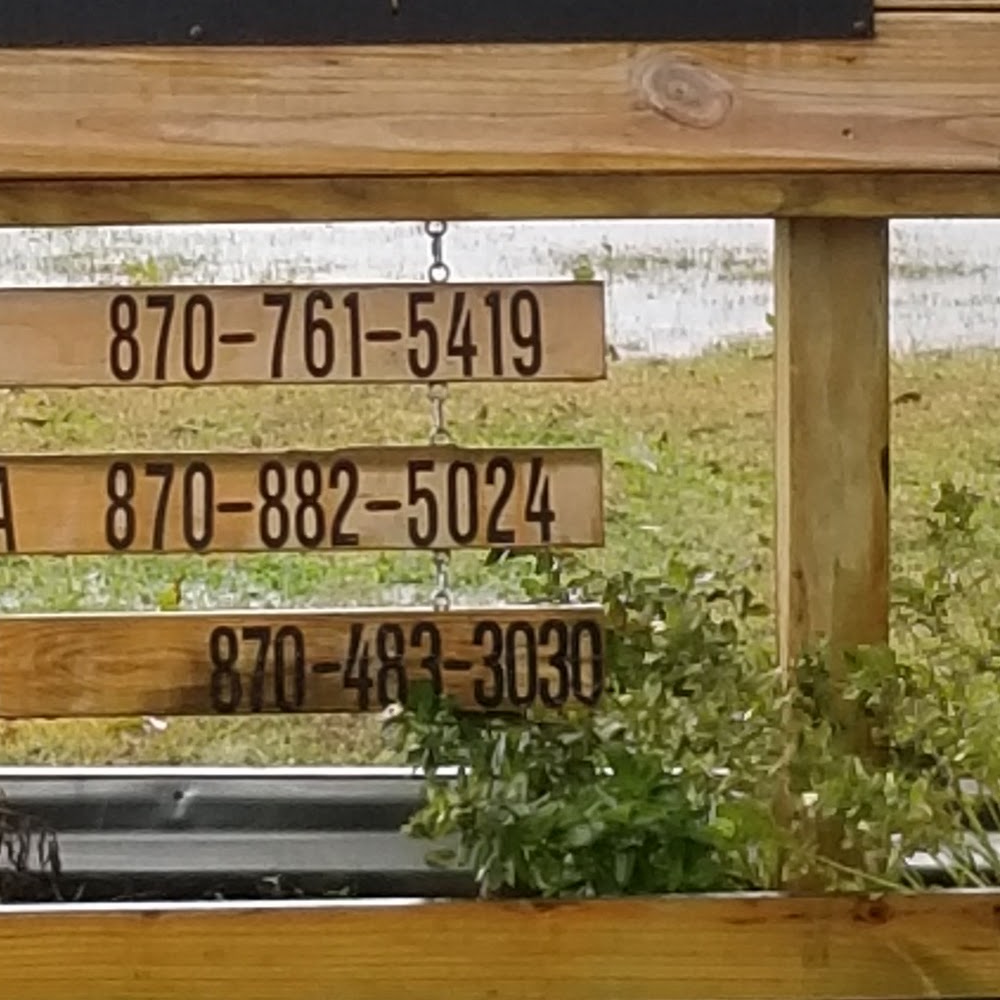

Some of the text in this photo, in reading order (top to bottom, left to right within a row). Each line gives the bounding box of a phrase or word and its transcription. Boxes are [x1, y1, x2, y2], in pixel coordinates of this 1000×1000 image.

[109, 289, 543, 382] 870-761-5419
[105, 457, 557, 550] 870-882-5024
[208, 619, 604, 714] 870-483-3030
